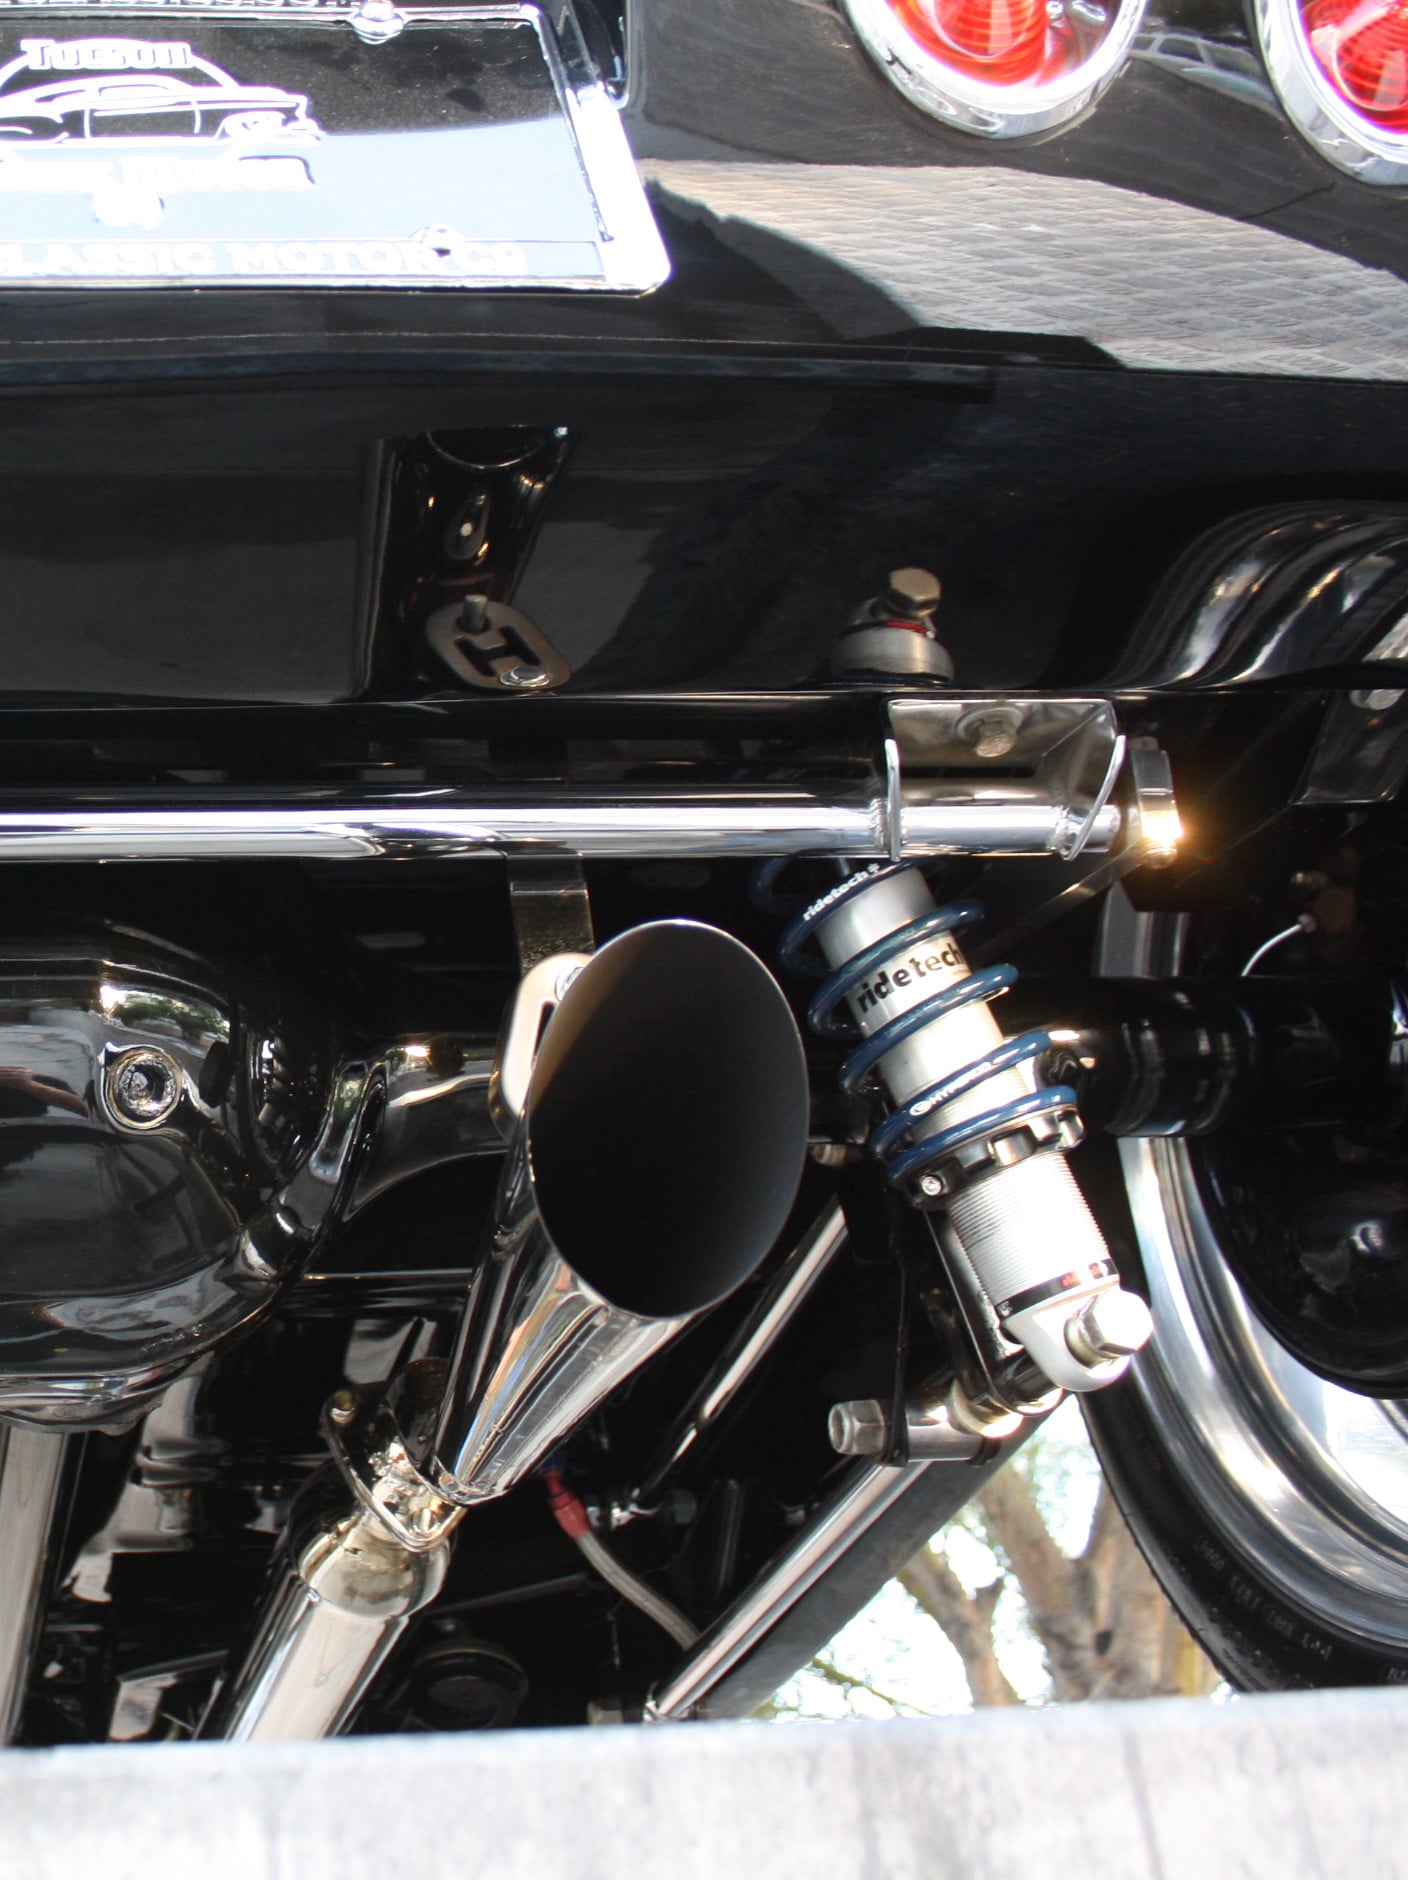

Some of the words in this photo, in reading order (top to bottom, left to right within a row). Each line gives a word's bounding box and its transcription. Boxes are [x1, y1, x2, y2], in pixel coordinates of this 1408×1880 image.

[21, 38, 192, 70] Tucson
[803, 870, 869, 921] ridetech
[856, 943, 966, 1014] ridetech
